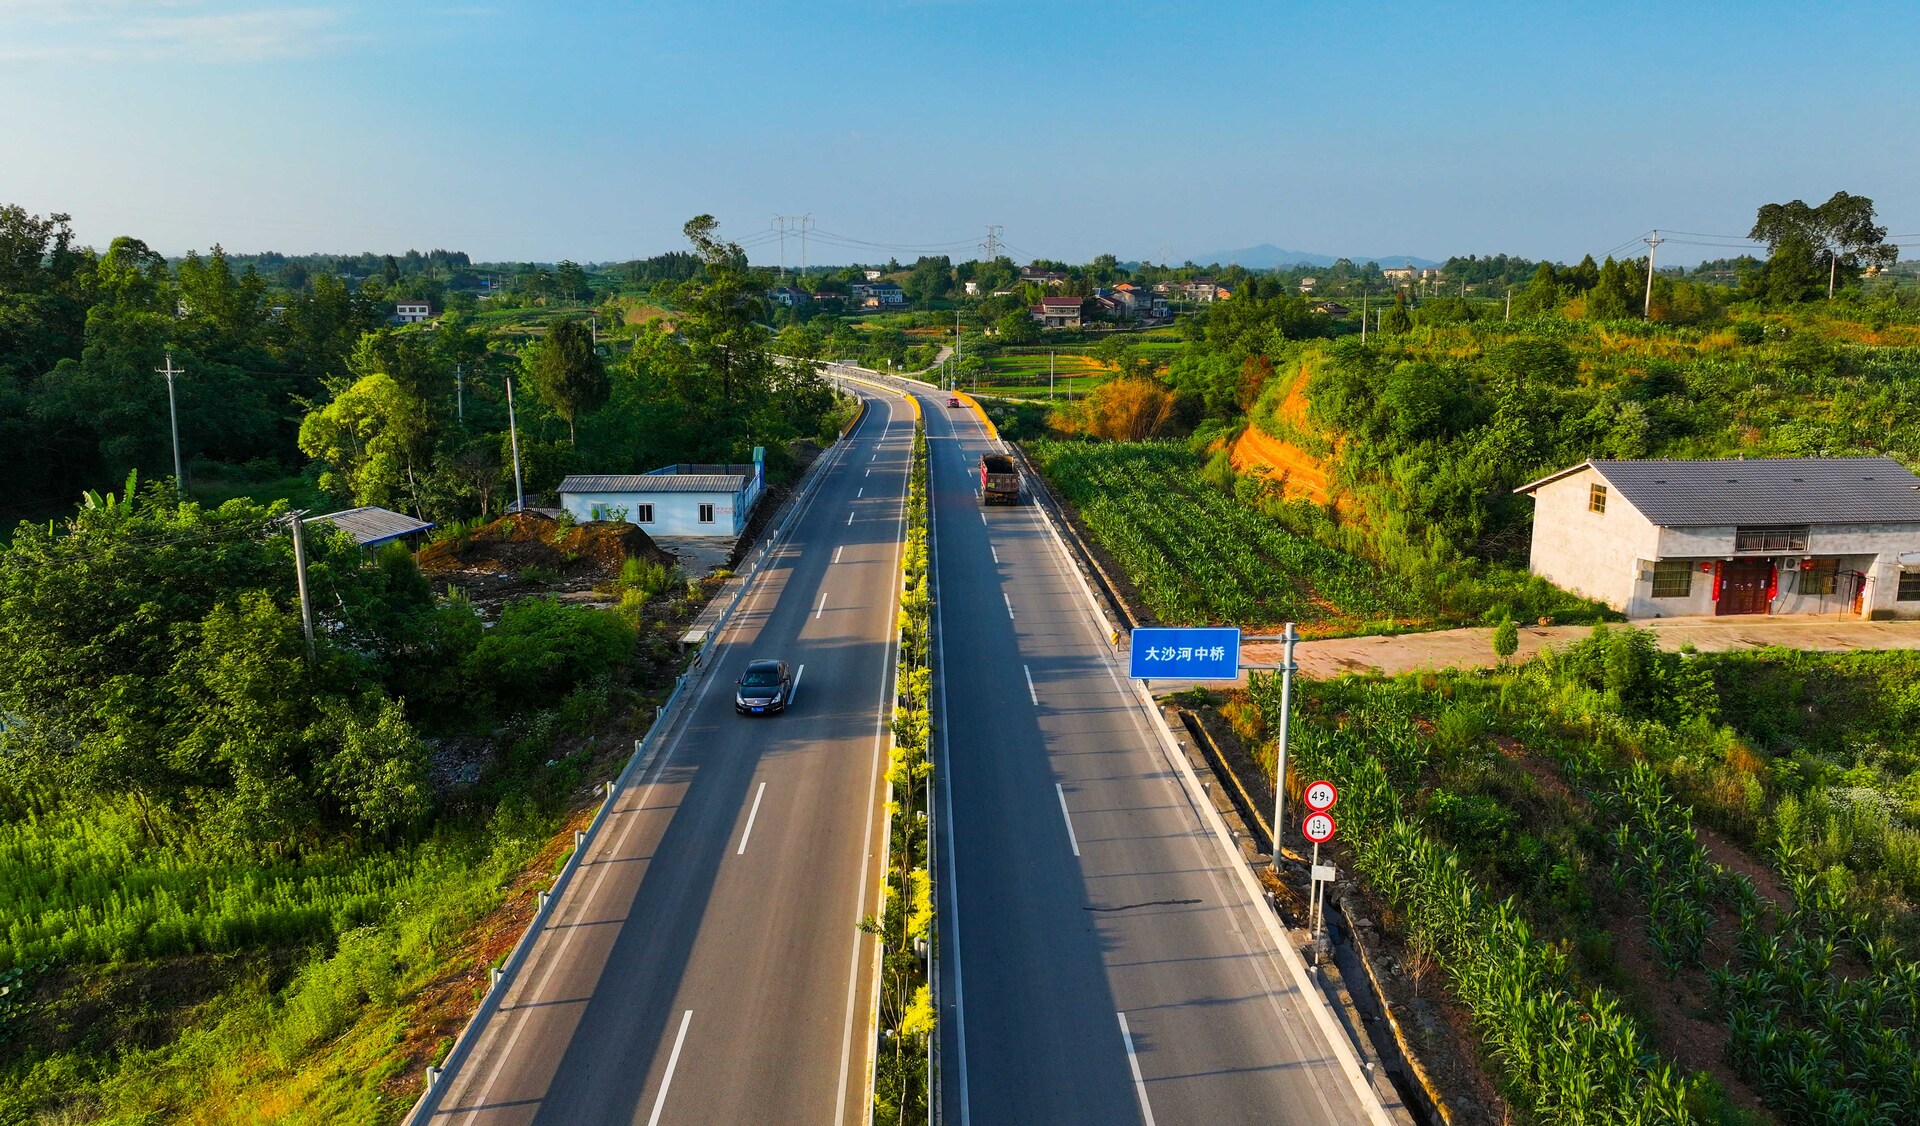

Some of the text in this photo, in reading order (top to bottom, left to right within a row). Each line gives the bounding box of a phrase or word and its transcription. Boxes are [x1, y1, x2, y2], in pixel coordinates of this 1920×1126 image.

[1144, 646, 1225, 662] 大沙河中桥
[1311, 791, 1330, 801] 49t
[1312, 819, 1326, 829] 13t
